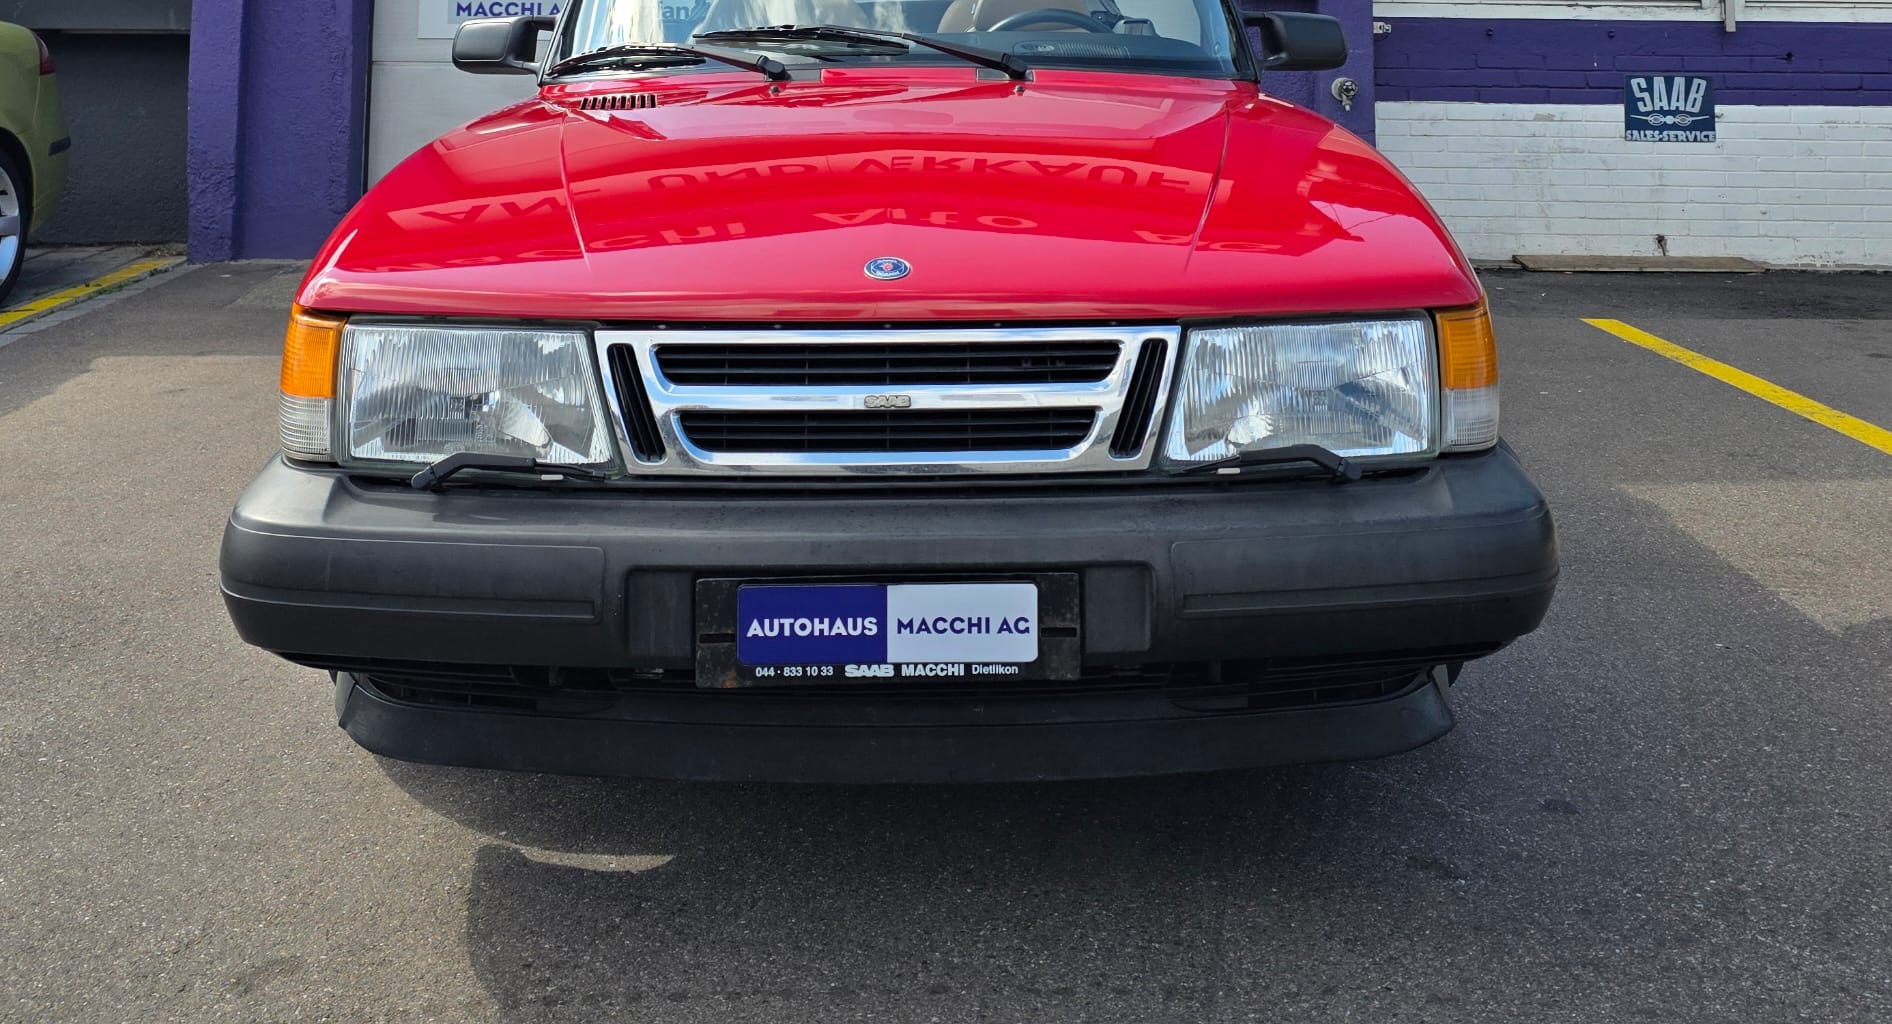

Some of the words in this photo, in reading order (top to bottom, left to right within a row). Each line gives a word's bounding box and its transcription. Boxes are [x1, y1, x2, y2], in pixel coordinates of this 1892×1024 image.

[456, 1, 542, 17] MACCHI
[1630, 76, 1707, 113] SAAB
[1626, 130, 1715, 142] SALES-SERVICE
[864, 395, 911, 408] SAAB
[746, 617, 878, 637] AUTOHAUS
[897, 617, 990, 635] MACCHI
[996, 617, 1030, 634] AG
[755, 667, 774, 677] 044
[783, 666, 802, 676] 833
[806, 666, 818, 676] 10
[821, 666, 834, 675] 33
[845, 664, 895, 677] SAAB
[901, 664, 964, 676] MACCHI
[971, 664, 1019, 674] Dietlikon
